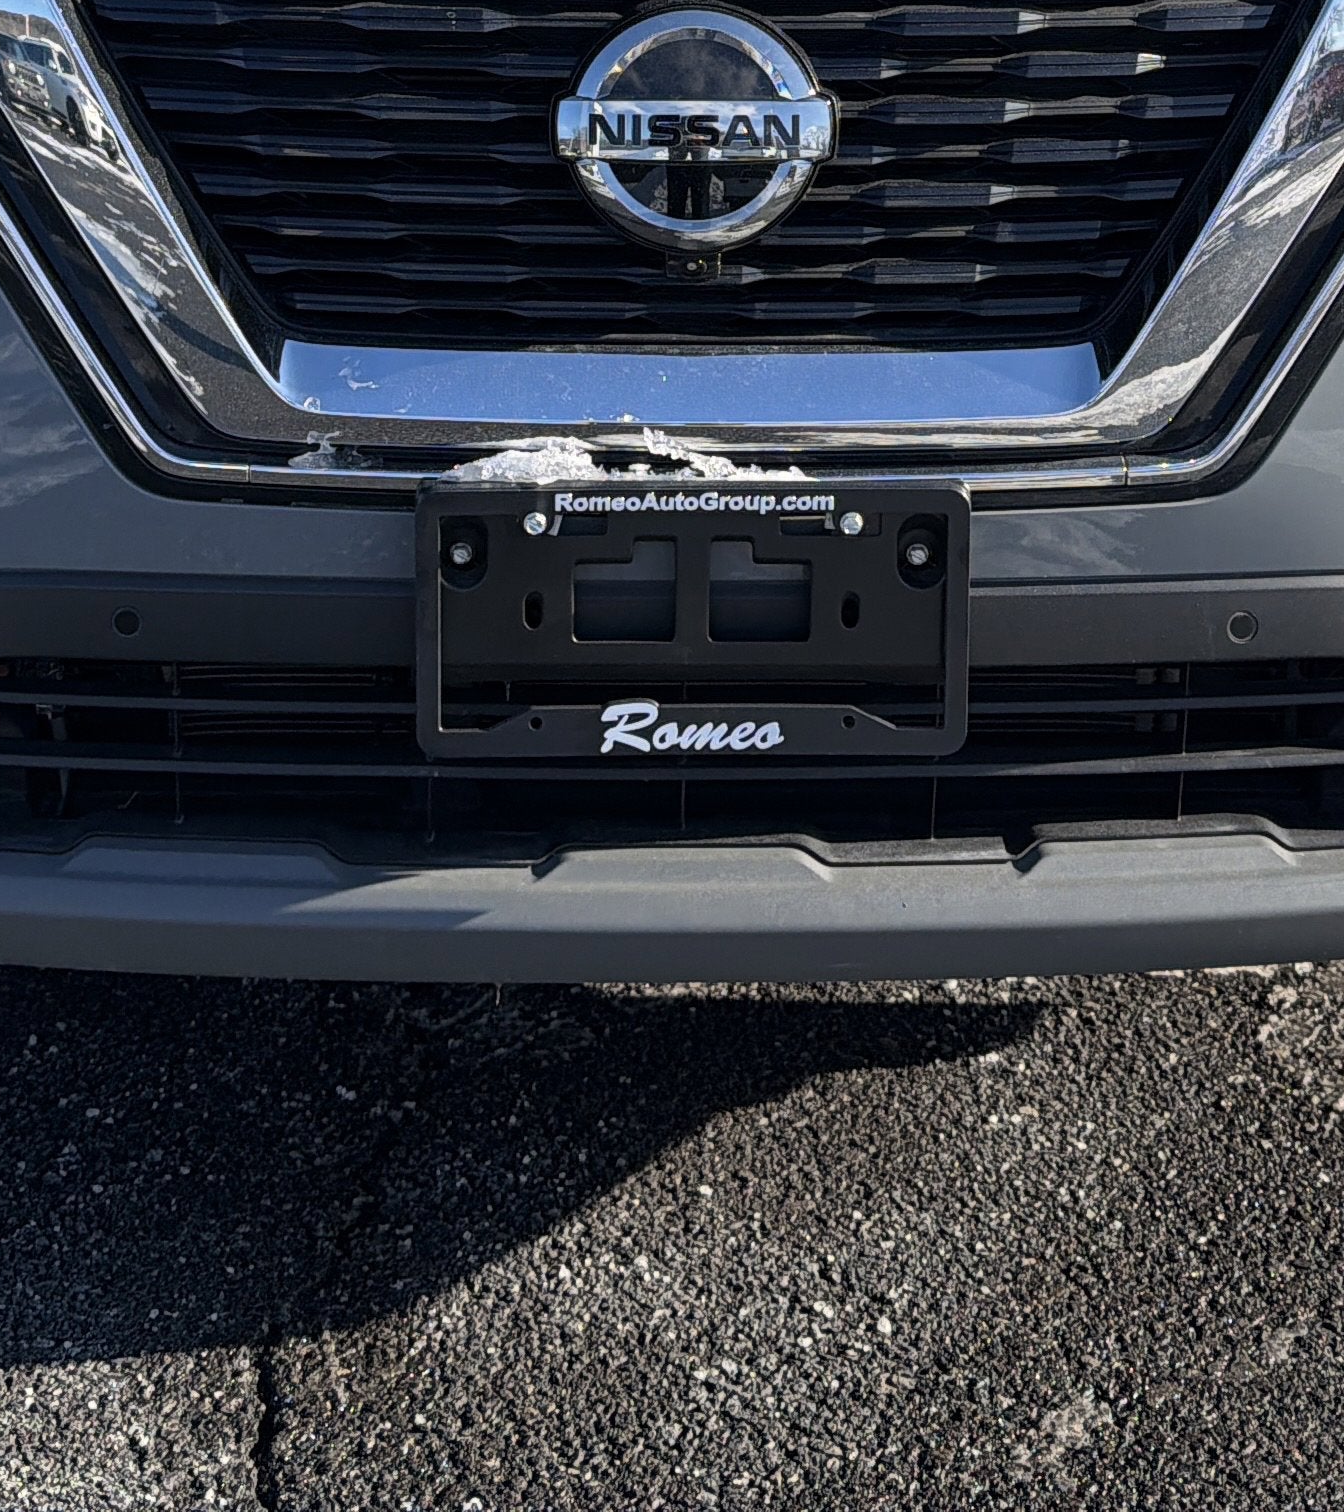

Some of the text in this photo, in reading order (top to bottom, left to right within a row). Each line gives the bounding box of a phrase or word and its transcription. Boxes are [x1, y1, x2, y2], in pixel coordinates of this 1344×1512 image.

[588, 113, 801, 147] NISSAN
[554, 492, 835, 514] RomeoAutoGroup.com
[600, 701, 785, 753] Romeo
